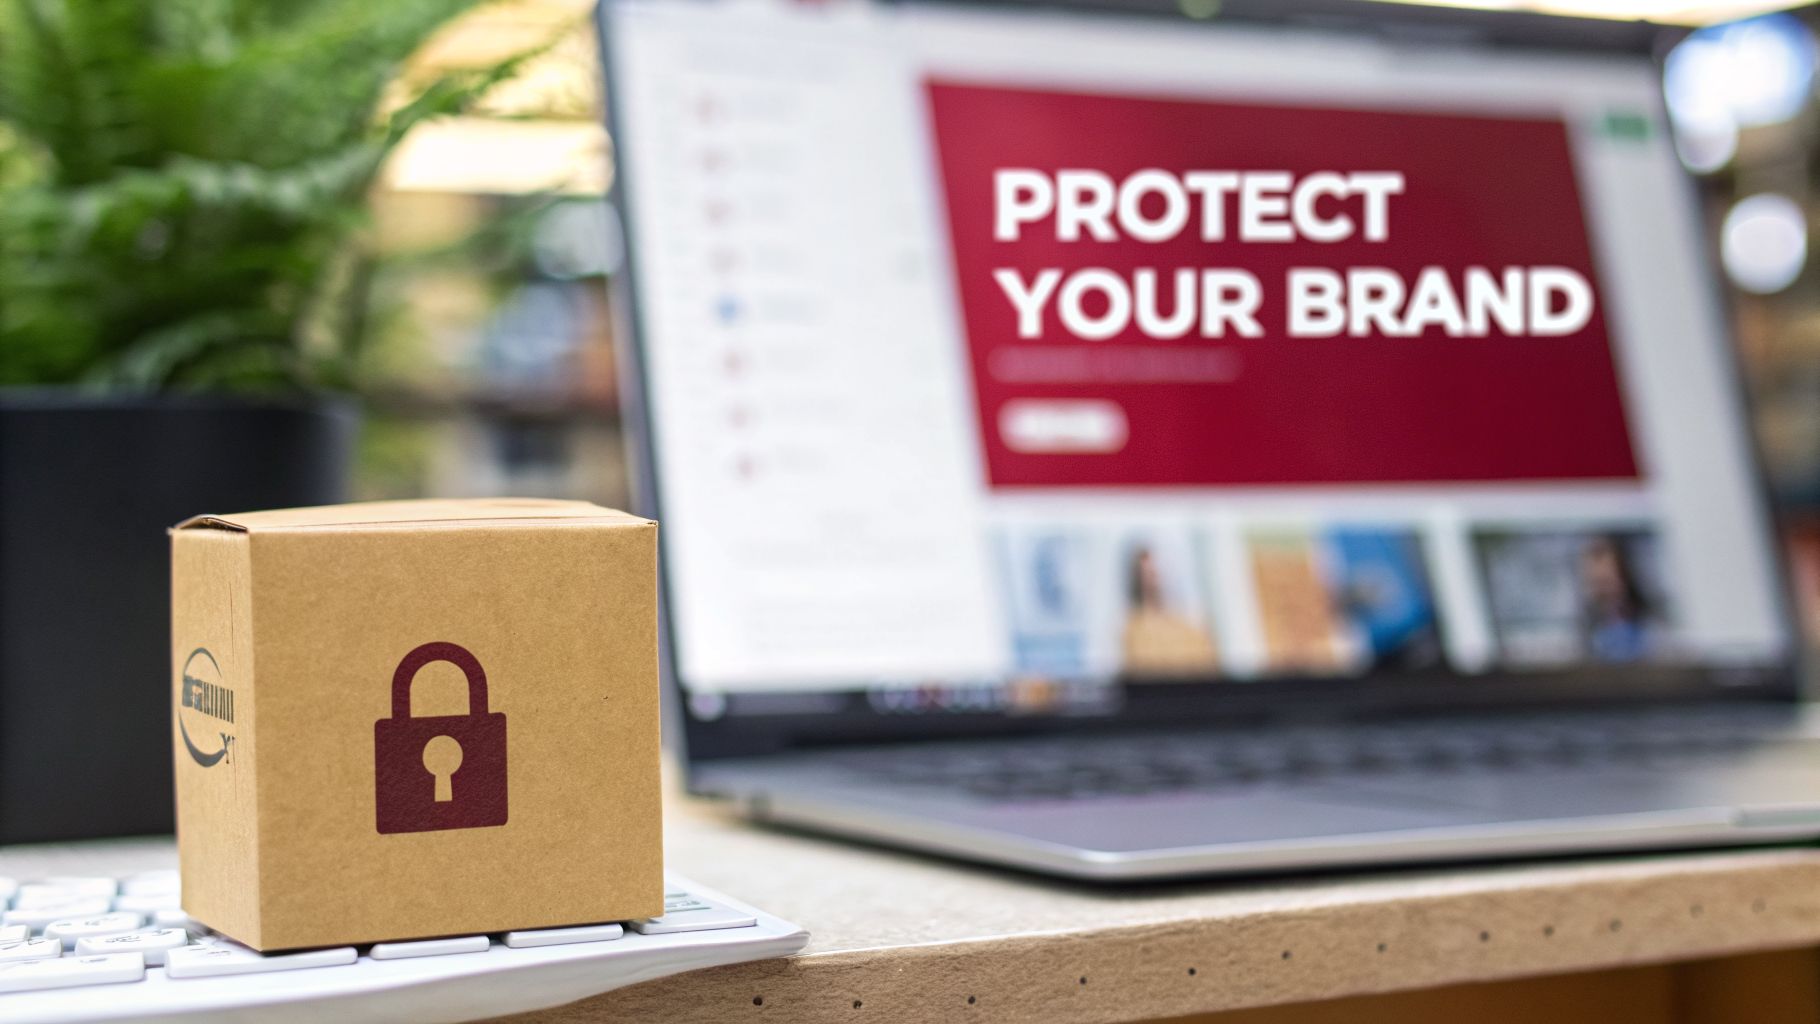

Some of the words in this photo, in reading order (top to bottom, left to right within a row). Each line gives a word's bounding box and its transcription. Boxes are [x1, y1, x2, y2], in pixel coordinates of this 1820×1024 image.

[993, 168, 1404, 242] PROTECT
[992, 267, 1264, 340] YOUR
[1287, 266, 1594, 337] BRAND
